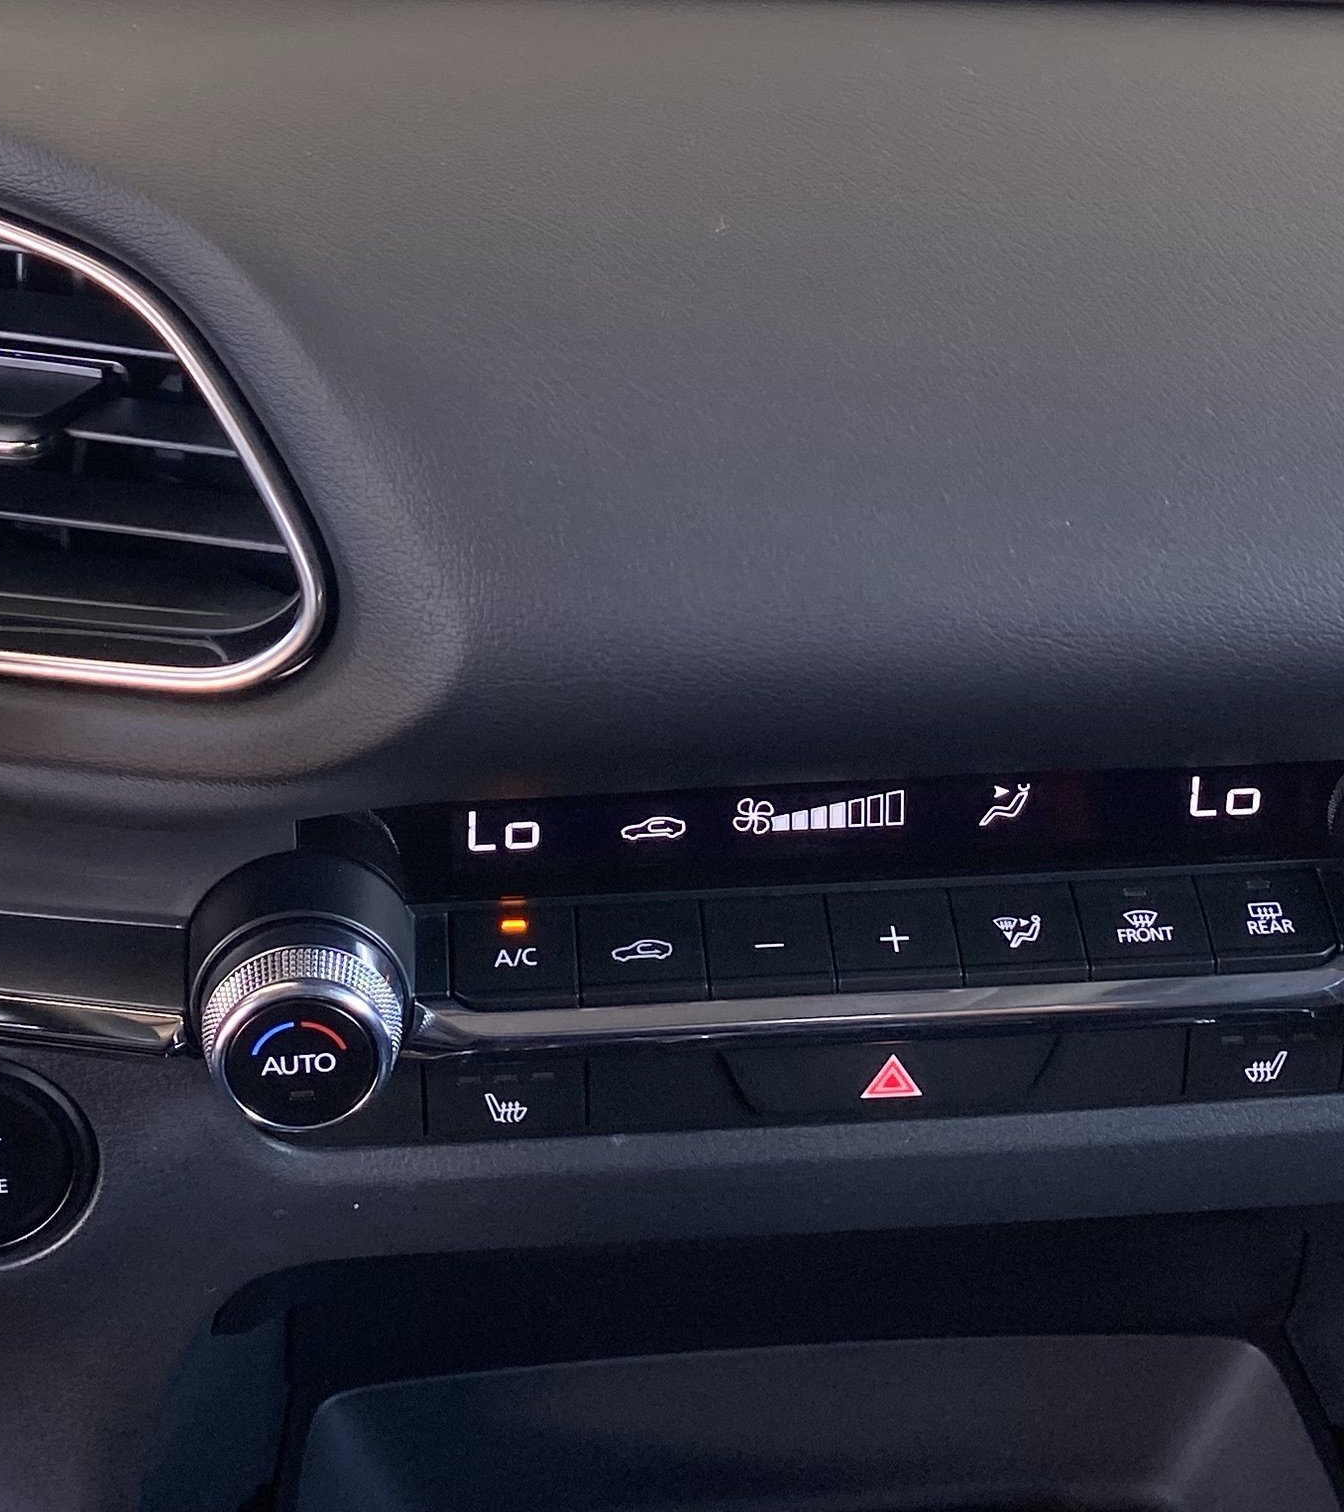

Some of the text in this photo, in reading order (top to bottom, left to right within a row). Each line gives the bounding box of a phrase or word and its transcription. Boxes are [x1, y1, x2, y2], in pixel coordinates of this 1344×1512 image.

[1189, 775, 1261, 818] Lo
[466, 810, 539, 852] Lo
[1116, 924, 1174, 945] FRONT
[1246, 916, 1295, 936] REAR
[494, 946, 538, 968] A/C
[260, 1051, 337, 1078] AUTO
